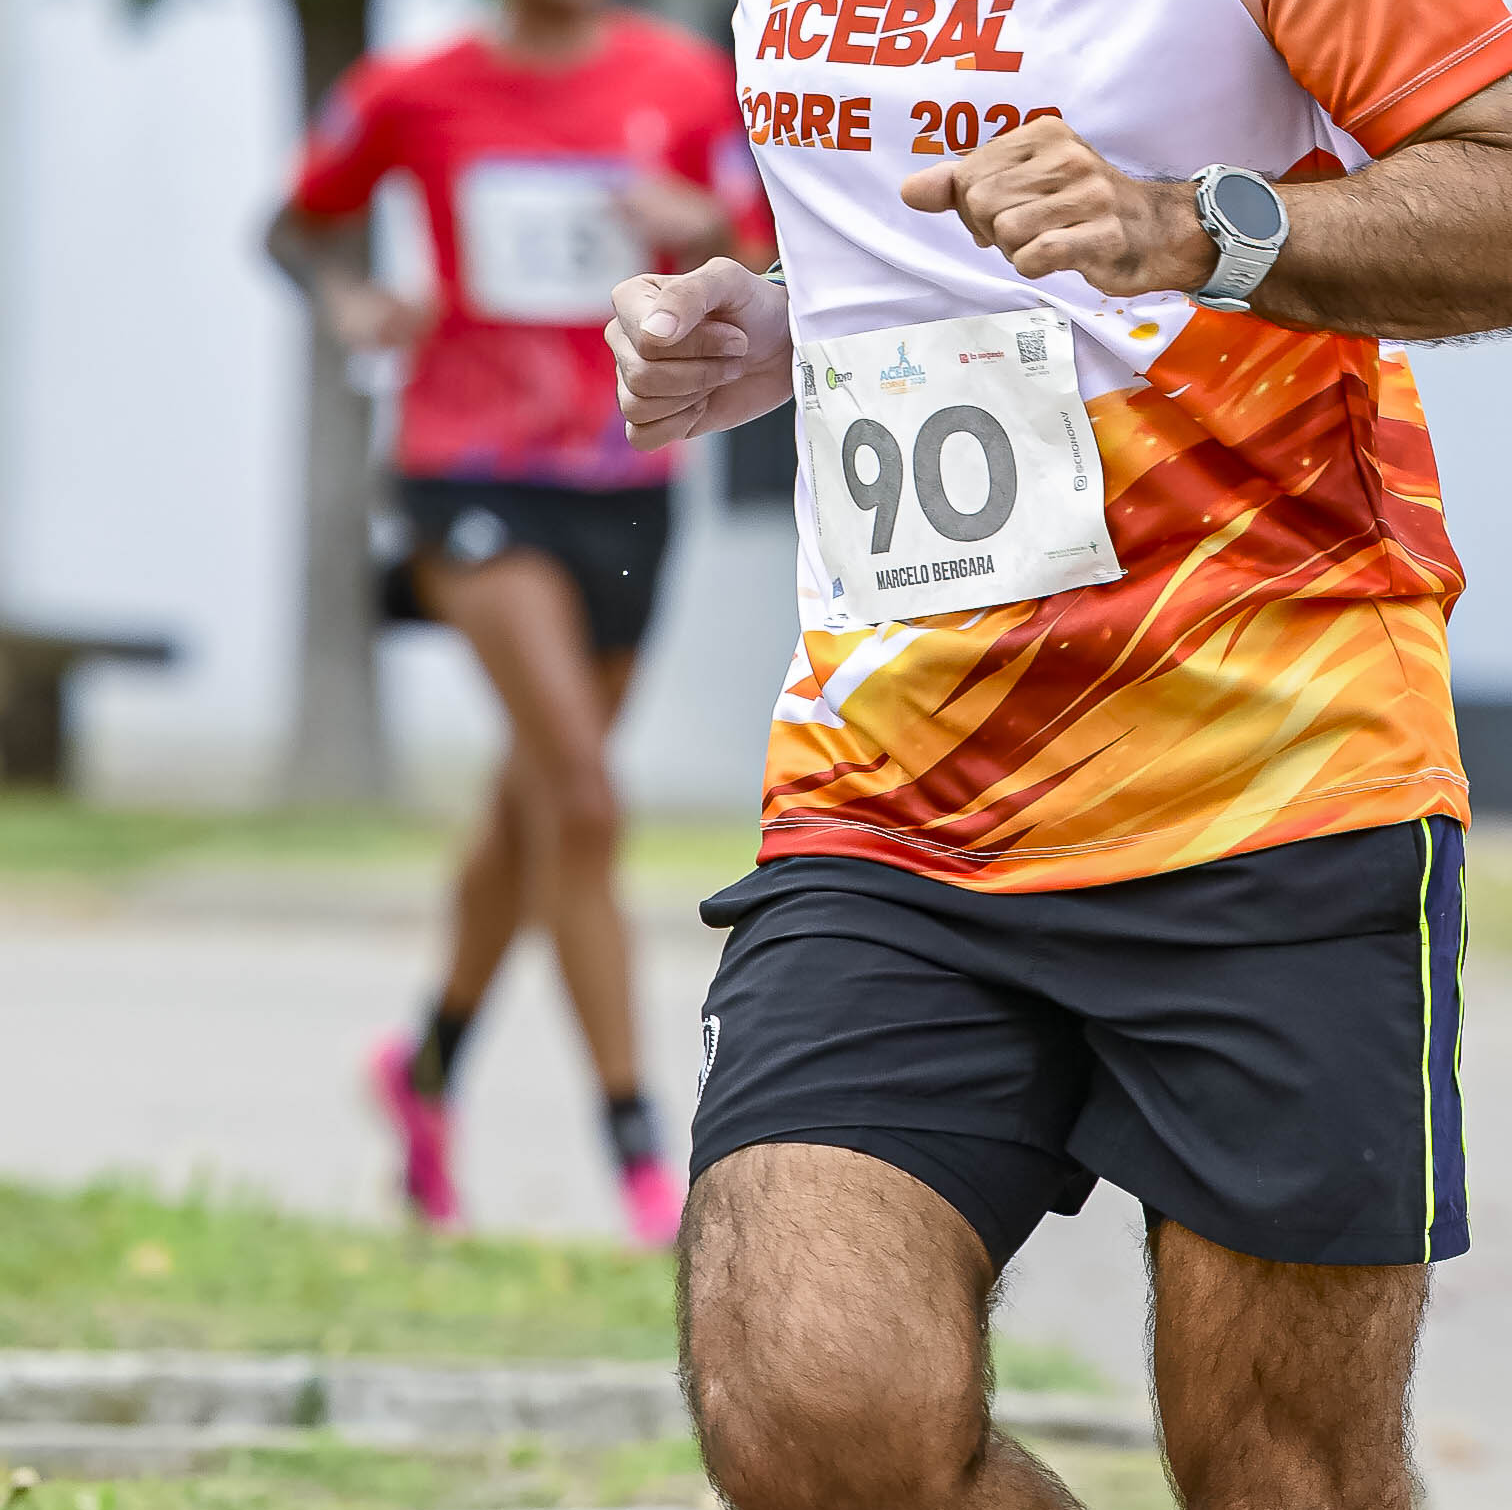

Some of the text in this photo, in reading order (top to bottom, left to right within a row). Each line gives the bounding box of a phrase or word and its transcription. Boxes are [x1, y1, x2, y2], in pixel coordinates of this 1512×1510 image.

[910, 100, 1063, 156] 202
[842, 404, 1017, 555] 90
[876, 554, 995, 590] MARCELO BERGARA
